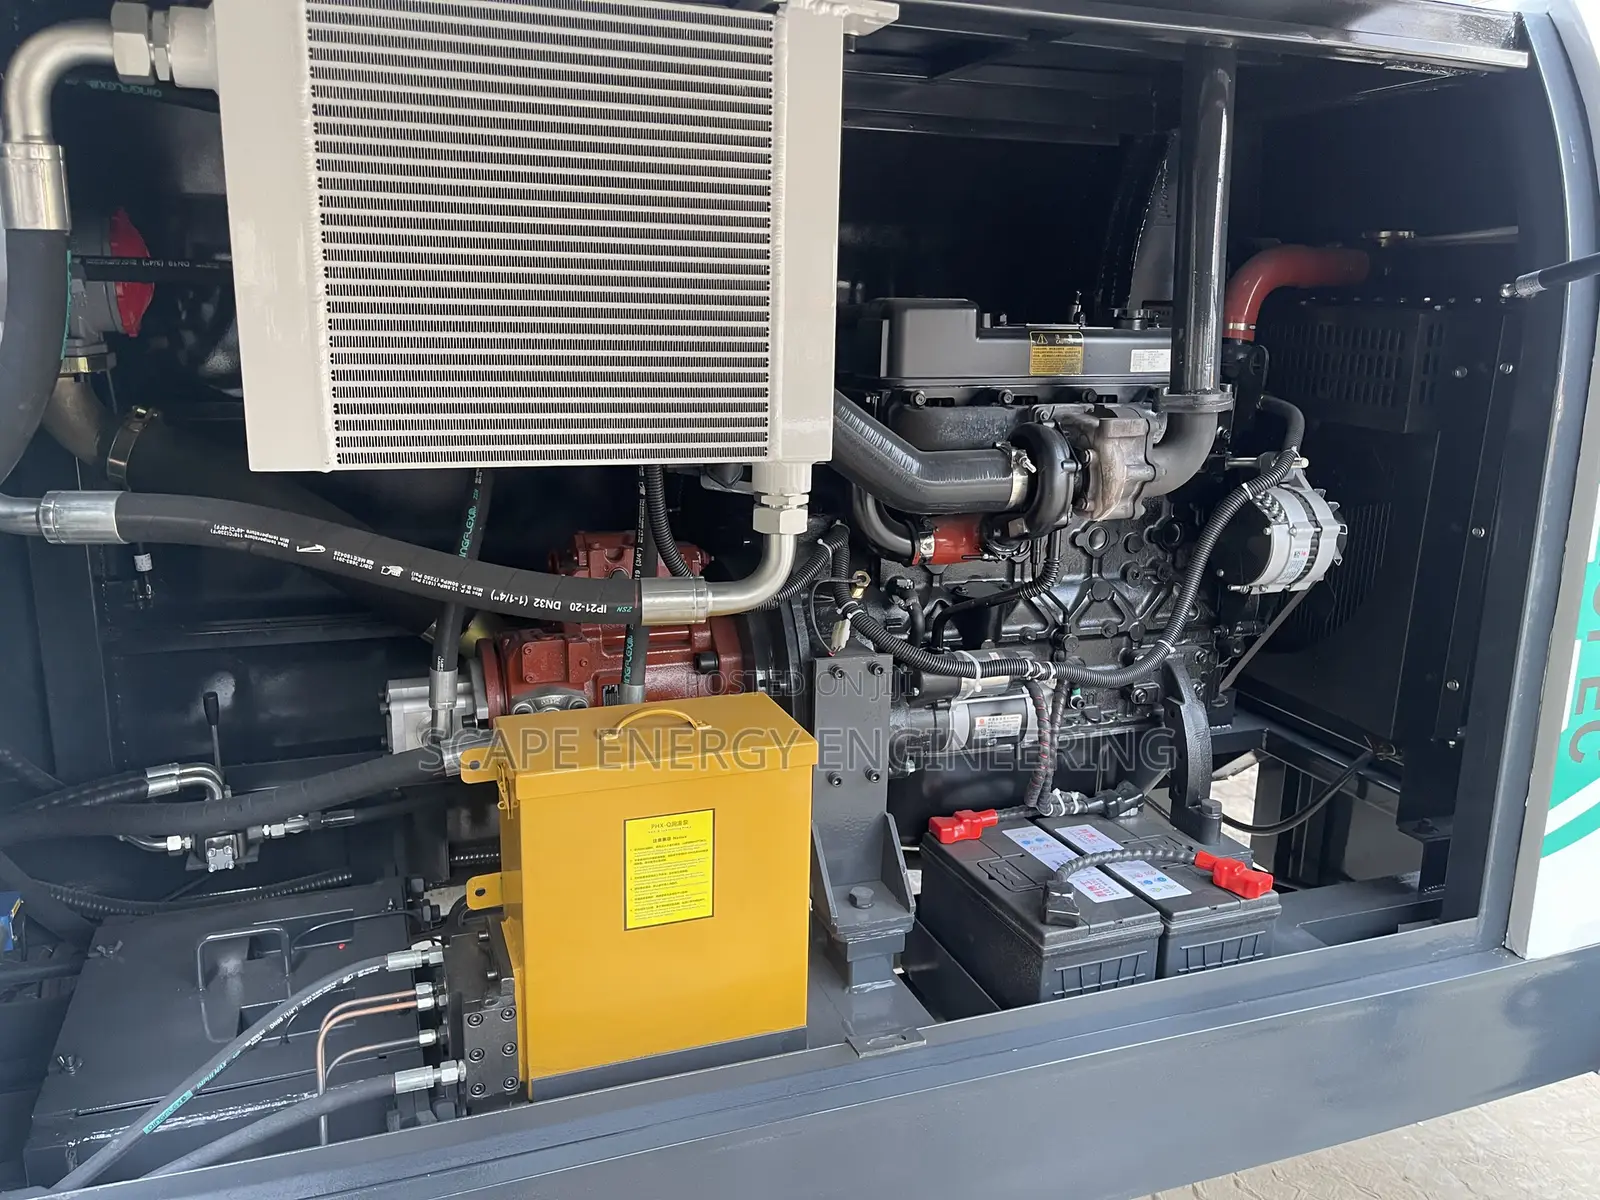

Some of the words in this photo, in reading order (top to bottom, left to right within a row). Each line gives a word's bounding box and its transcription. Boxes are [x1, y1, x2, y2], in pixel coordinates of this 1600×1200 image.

[490, 589, 529, 607] (1-1/4")
[533, 598, 562, 611] DN32
[569, 602, 608, 613] IP21-20
